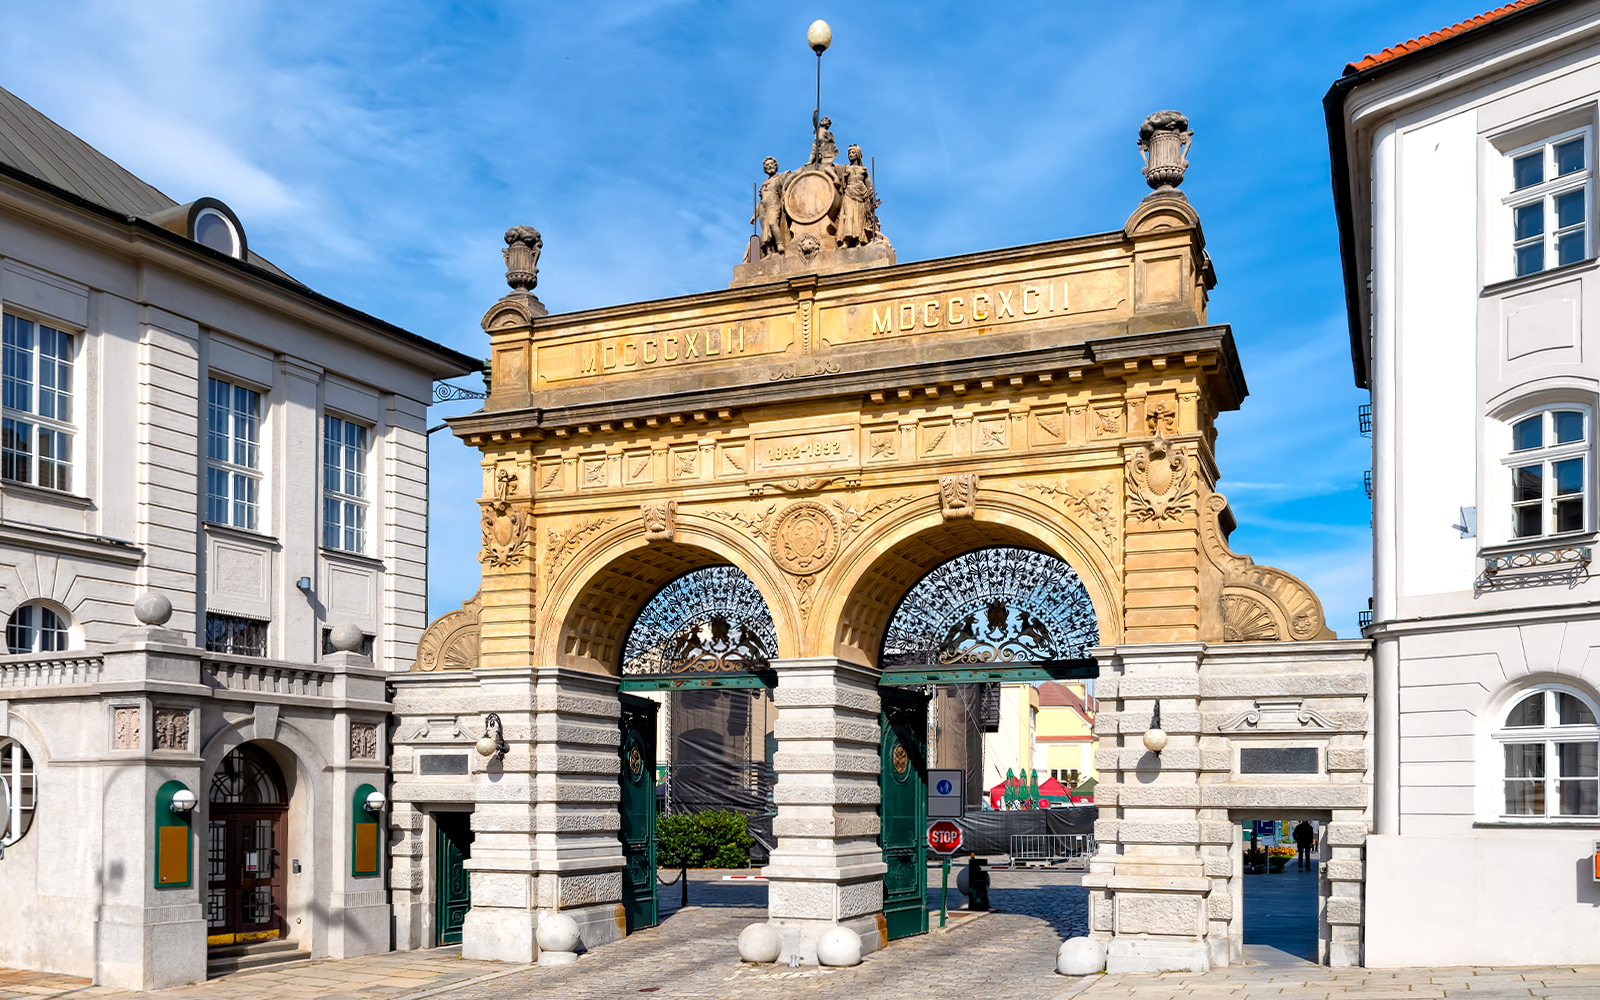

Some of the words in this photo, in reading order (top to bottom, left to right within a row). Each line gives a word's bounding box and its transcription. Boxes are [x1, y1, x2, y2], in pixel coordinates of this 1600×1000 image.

[872, 281, 1069, 335] MDCCCXCII
[580, 325, 745, 373] MDCCCXLII
[768, 441, 840, 461] 1842-1892
[932, 830, 957, 843] STOP
